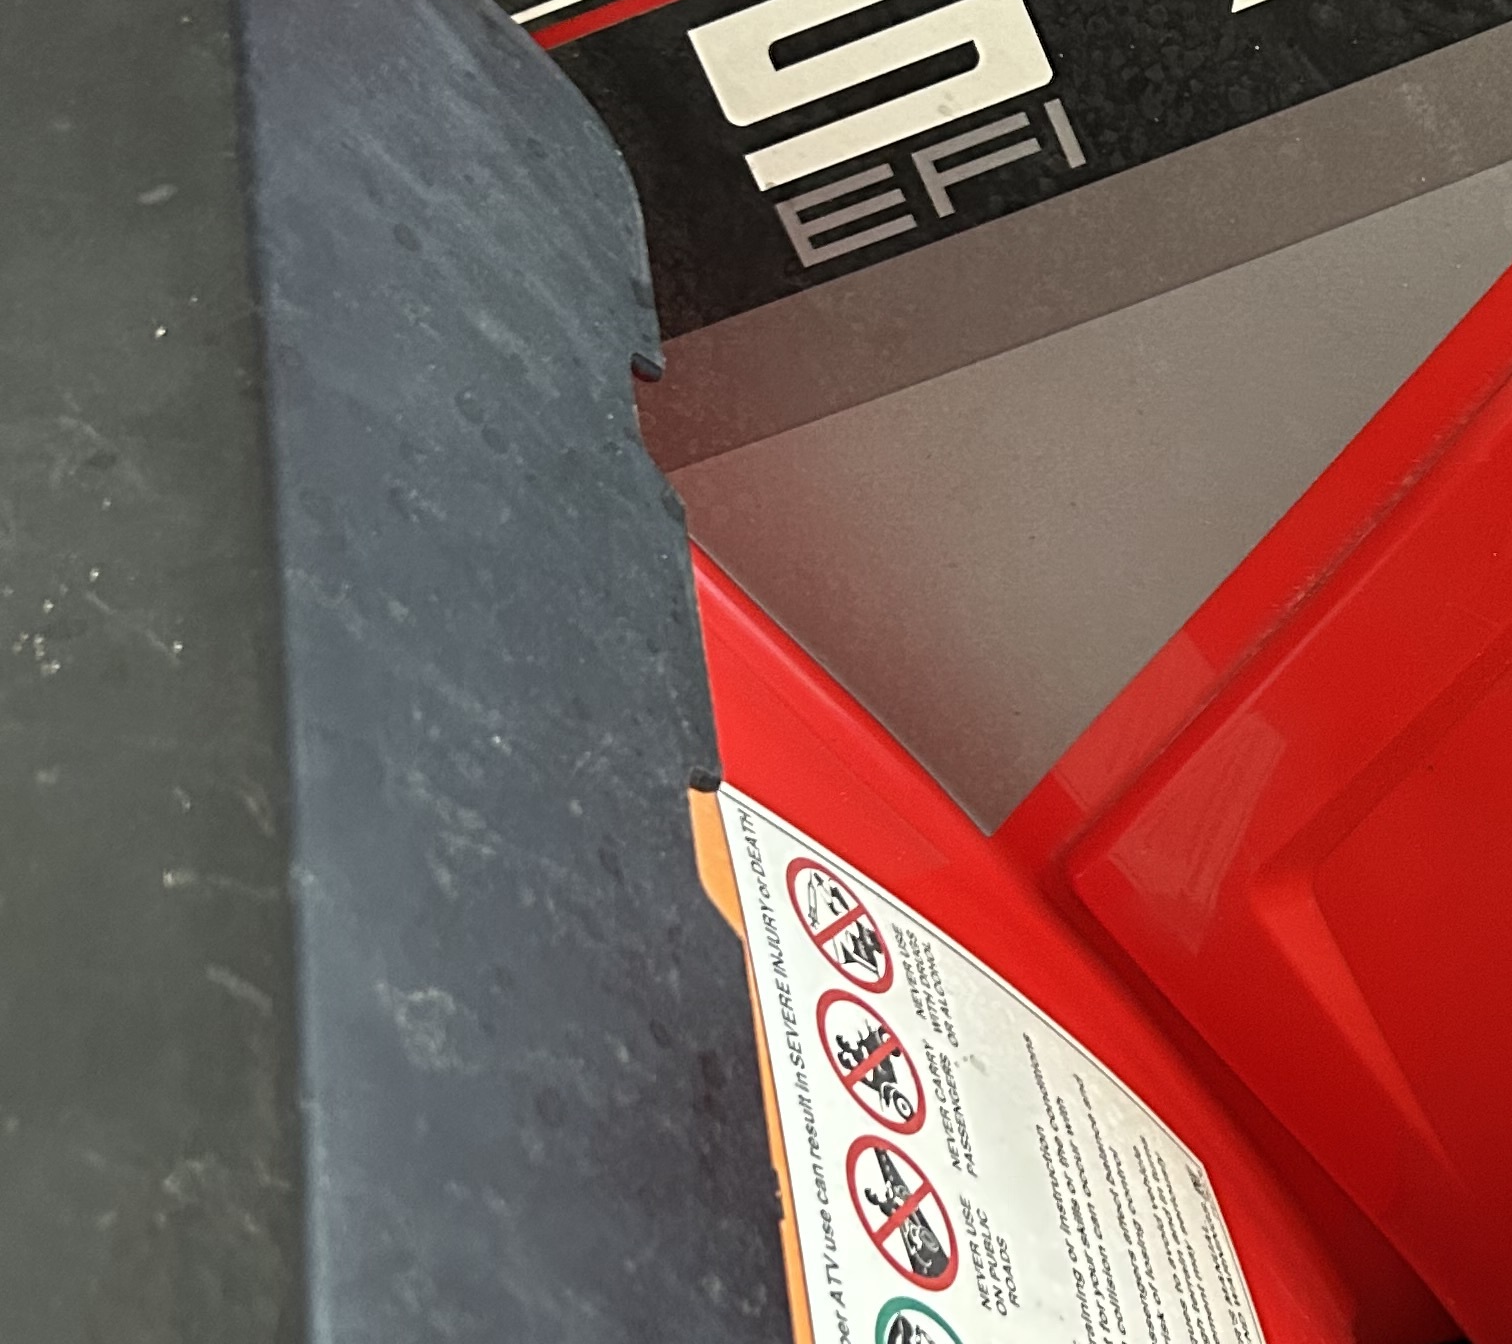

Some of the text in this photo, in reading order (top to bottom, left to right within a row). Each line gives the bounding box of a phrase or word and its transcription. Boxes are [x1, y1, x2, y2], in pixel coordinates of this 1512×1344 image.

[774, 97, 1088, 268] EFI
[738, 808, 765, 877] DEATH
[757, 876, 770, 899] or
[759, 898, 787, 978] INJURY
[775, 978, 805, 1069] SEVERE
[795, 1072, 809, 1092] in
[923, 1039, 962, 1171] NEVER CARRY
[1073, 1074, 1092, 1110] and
[798, 1095, 821, 1160] result
[939, 1053, 978, 1178] PASSENGERS
[1036, 1124, 1071, 1235] instruction
[1054, 1136, 1069, 1168] the
[1069, 1139, 1091, 1198] occur
[812, 1163, 829, 1205] can
[1064, 1171, 1076, 1195] or
[820, 1209, 837, 1252] use
[1087, 1202, 1103, 1240] can
[1109, 1188, 1132, 1245] affect
[960, 1195, 992, 1311] NEVER USE
[976, 1208, 1007, 1316] ON PUBLIC
[996, 1236, 1020, 1308] ROADS
[1065, 1238, 1077, 1263] or
[1084, 1249, 1105, 1300] your
[823, 1253, 845, 1308] ATV
[1098, 1245, 1126, 1335] collision
[1148, 1282, 1161, 1305] of
[1096, 1299, 1110, 1333] for
